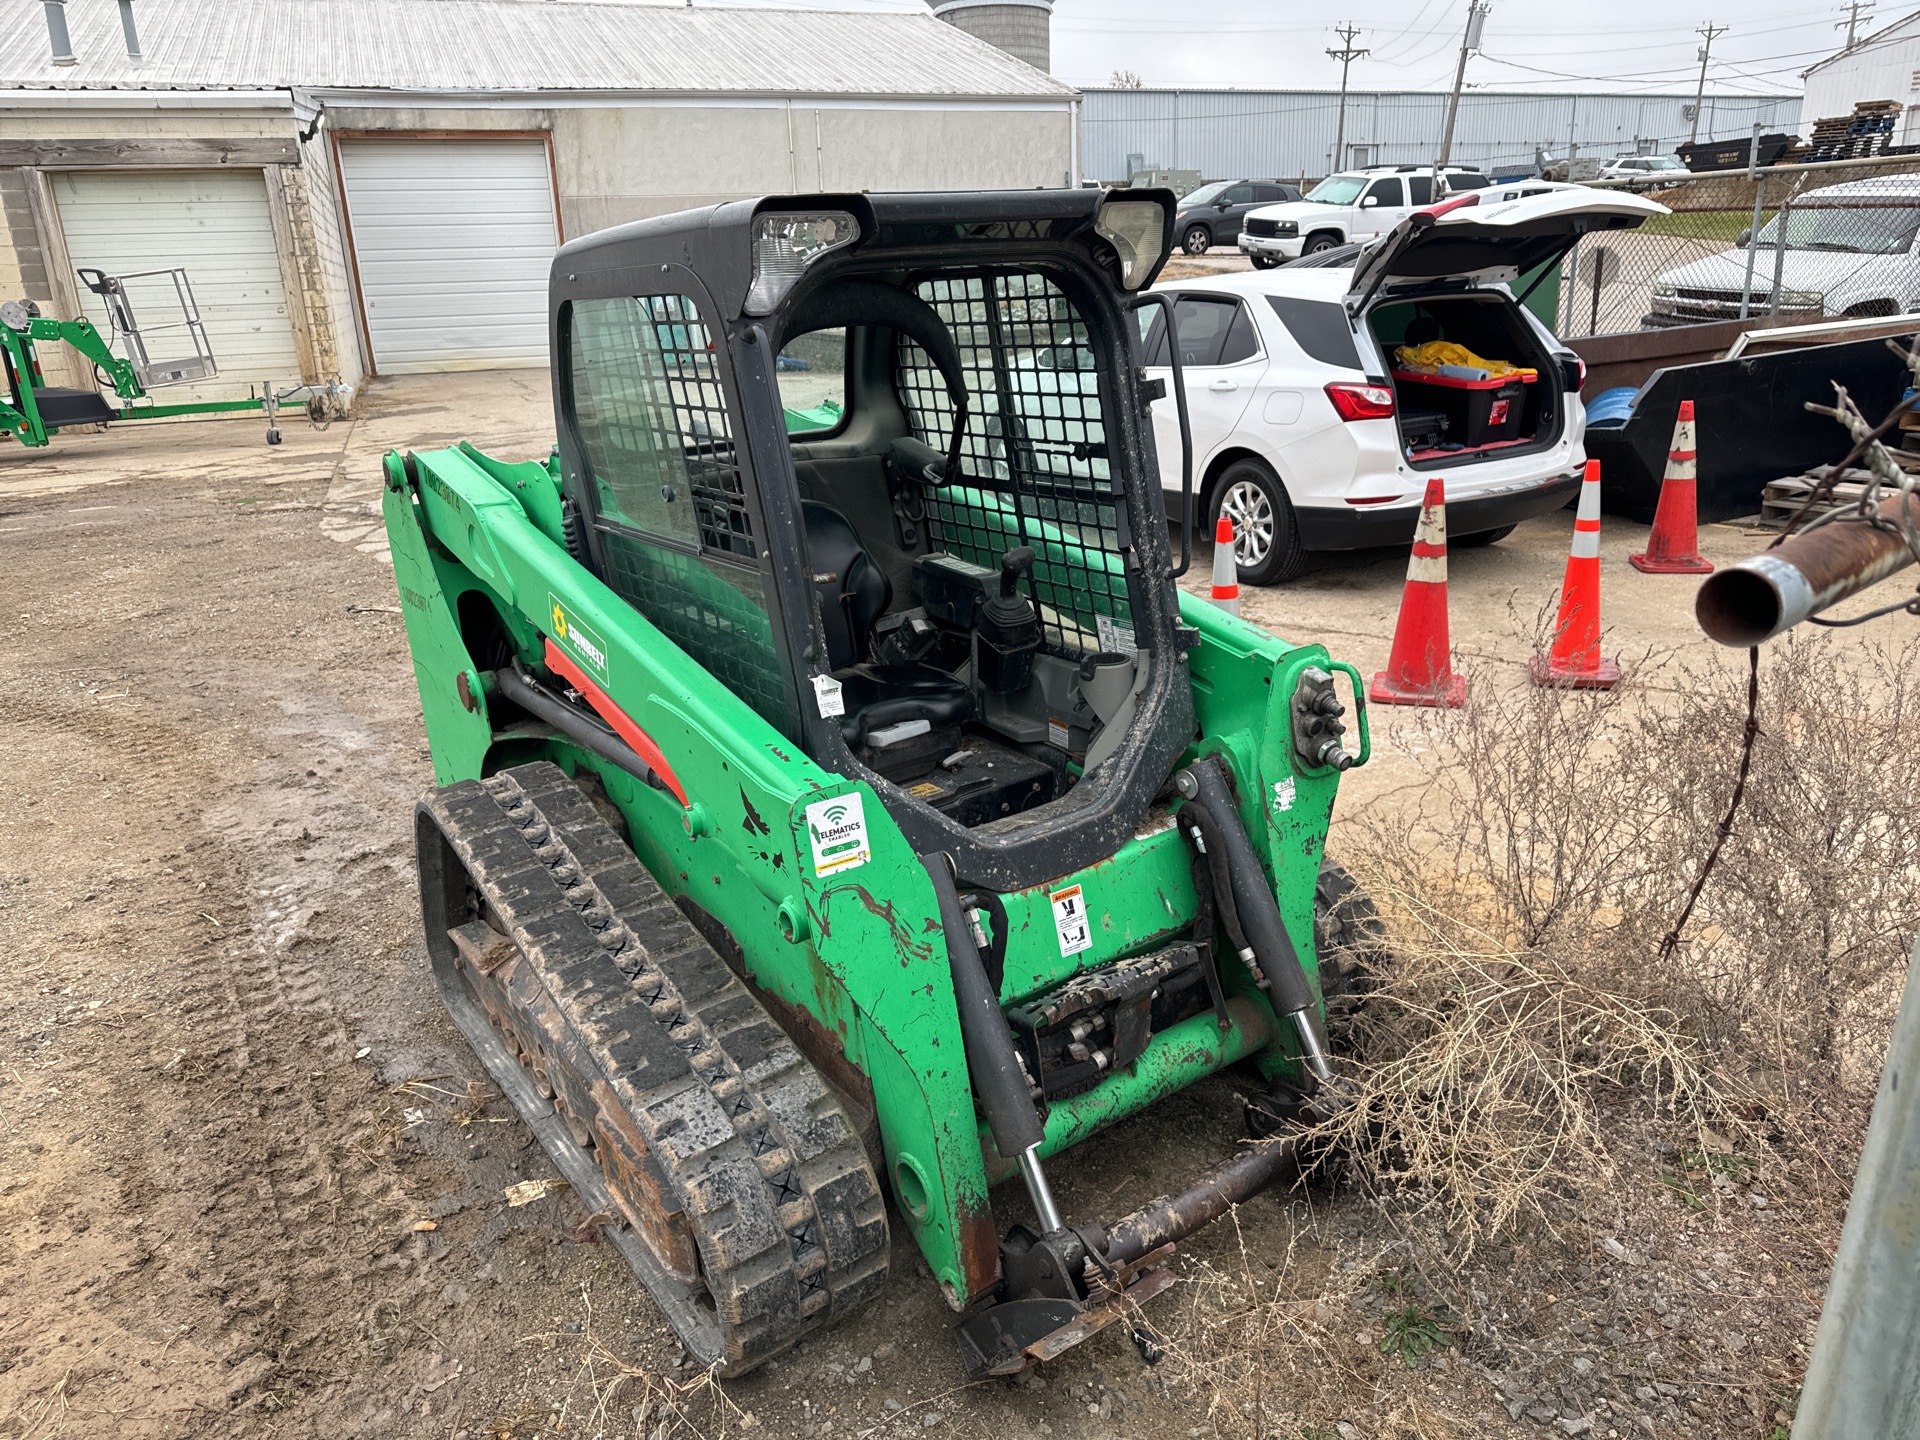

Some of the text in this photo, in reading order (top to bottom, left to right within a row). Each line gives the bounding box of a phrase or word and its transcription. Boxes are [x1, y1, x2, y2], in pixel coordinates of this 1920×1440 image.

[568, 623, 605, 669] SUNBELT
[573, 643, 601, 671] RENTALS
[819, 822, 861, 840] ELEMATICS
[828, 833, 851, 842] ENABLED
[1058, 889, 1079, 899] WARNING
